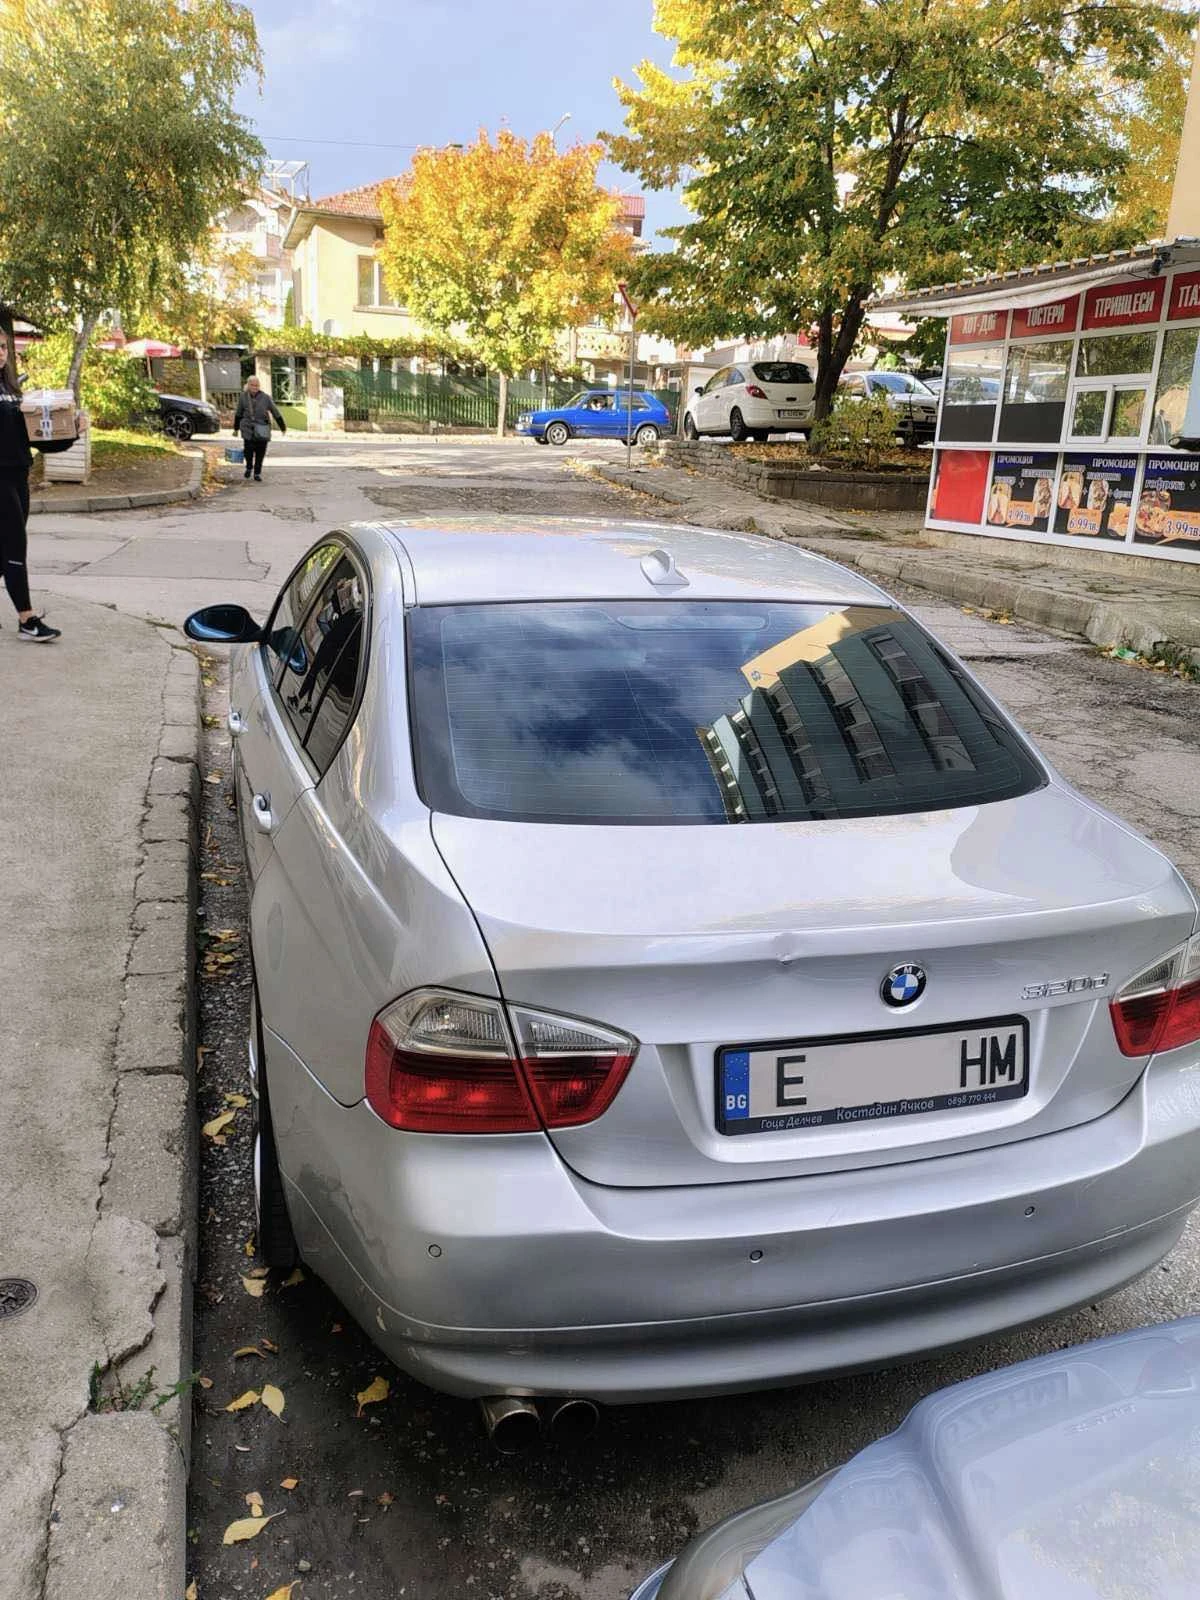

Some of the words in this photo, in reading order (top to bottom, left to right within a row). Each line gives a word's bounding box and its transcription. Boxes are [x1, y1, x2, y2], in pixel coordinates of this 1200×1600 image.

[1094, 290, 1156, 319] ПРИНЦЕСИ
[1178, 284, 1200, 308] ПА
[1026, 304, 1066, 328] ТОСТЕРИ
[1092, 458, 1137, 469] ПРОМОЦИЯ
[1148, 459, 1200, 471] ПРОМОЦИЯ
[1020, 972, 1110, 1000] 320d
[776, 1055, 807, 1107] E
[959, 1033, 1017, 1088] HM
[726, 1094, 747, 1110] BG
[761, 1119, 785, 1129] Гоце
[786, 1115, 823, 1129] Делчев
[836, 1103, 897, 1121] Костадин
[900, 1099, 935, 1114] Ячков
